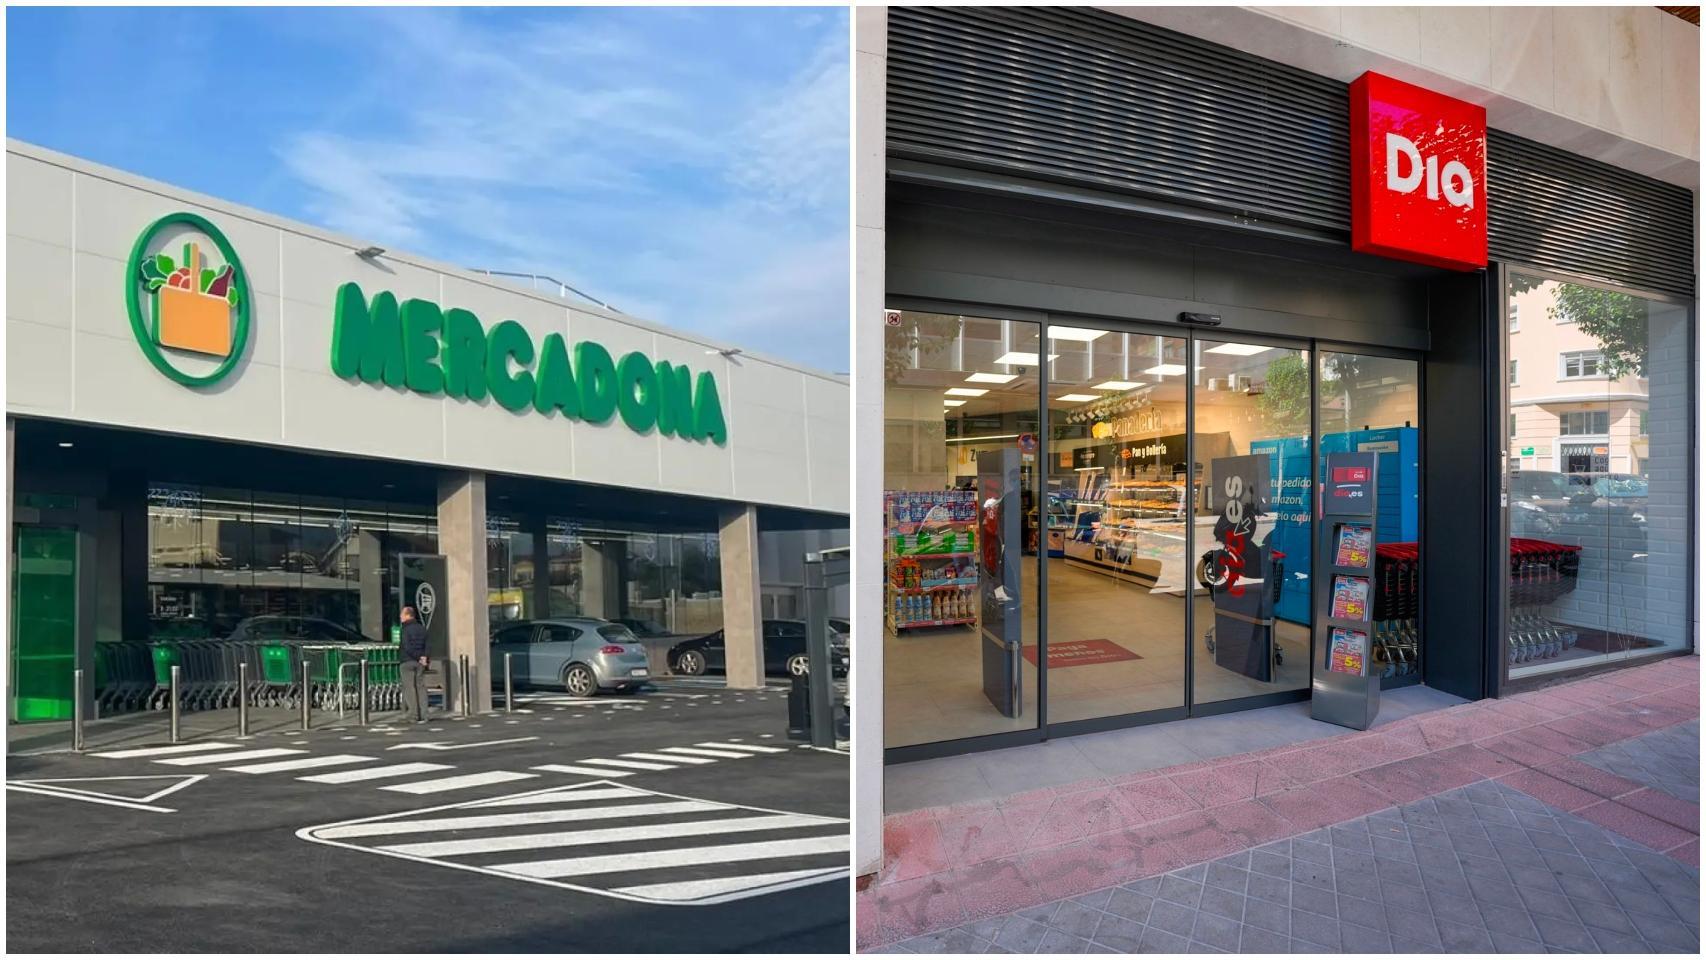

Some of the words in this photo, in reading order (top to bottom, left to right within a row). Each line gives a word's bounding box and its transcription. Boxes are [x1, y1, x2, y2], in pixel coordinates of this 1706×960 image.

[1386, 131, 1474, 210] Dia
[331, 281, 727, 447] MERCADONA
[1111, 407, 1163, 438] Panadería
[1132, 447, 1141, 458] Pan
[1146, 443, 1167, 457] Bollería
[1252, 446, 1277, 455] amazon
[1280, 477, 1312, 490] pedido
[1271, 496, 1304, 506] mazon,
